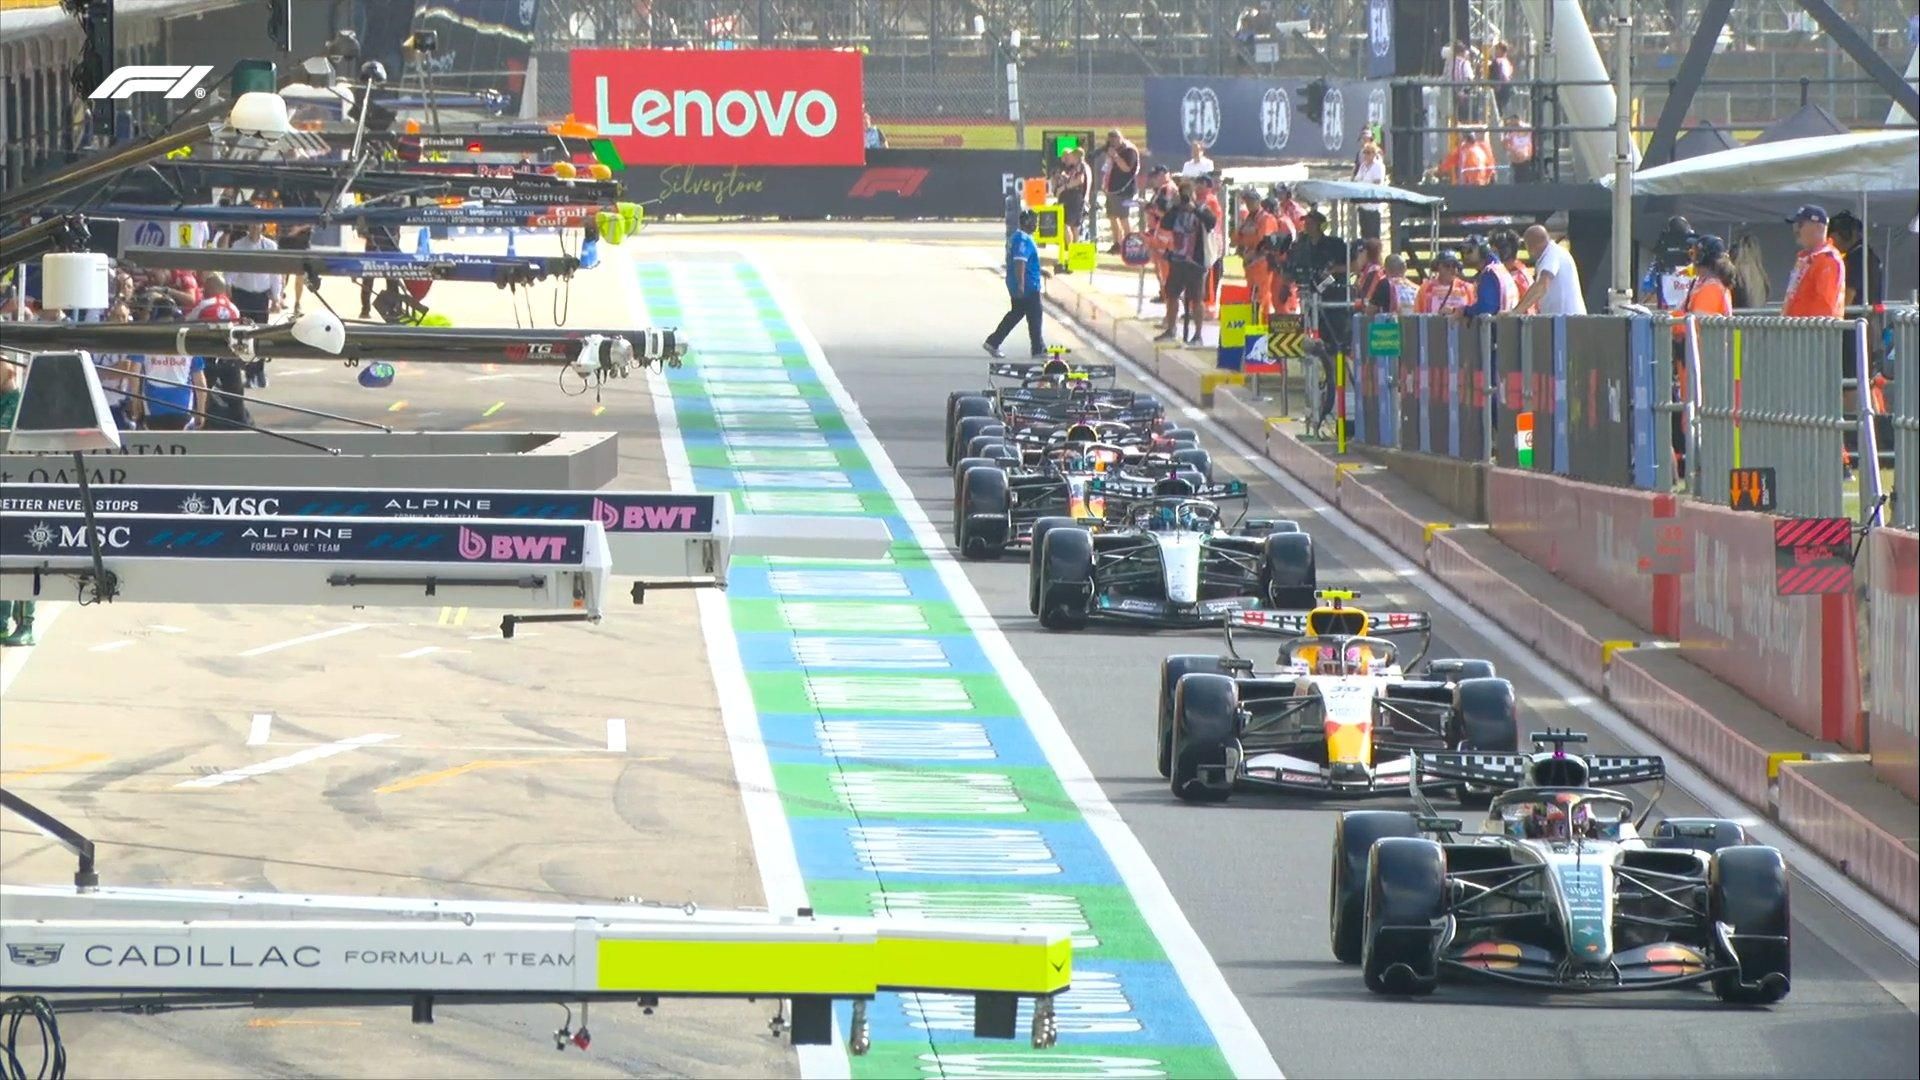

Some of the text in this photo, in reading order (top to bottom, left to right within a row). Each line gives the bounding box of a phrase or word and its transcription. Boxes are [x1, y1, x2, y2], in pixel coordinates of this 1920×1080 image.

[595, 76, 838, 138] Lenovo
[1184, 101, 1218, 136] FIA
[1261, 101, 1290, 135] FIA
[1323, 101, 1343, 135] FIA
[536, 217, 568, 226] Gulf
[555, 207, 587, 217] Gulf
[0, 499, 139, 512] ETTER NEVE STOPS
[211, 497, 279, 516] MSC
[385, 499, 491, 510] ALPINE
[622, 506, 697, 530] BWT
[241, 527, 353, 539] ALPINE
[250, 542, 290, 552] FORMULA
[318, 543, 341, 553] TEAM
[490, 536, 567, 560] BWT
[85, 945, 321, 968] CADILLAC
[344, 950, 474, 966] FORMULA
[503, 952, 575, 967] TEAM
